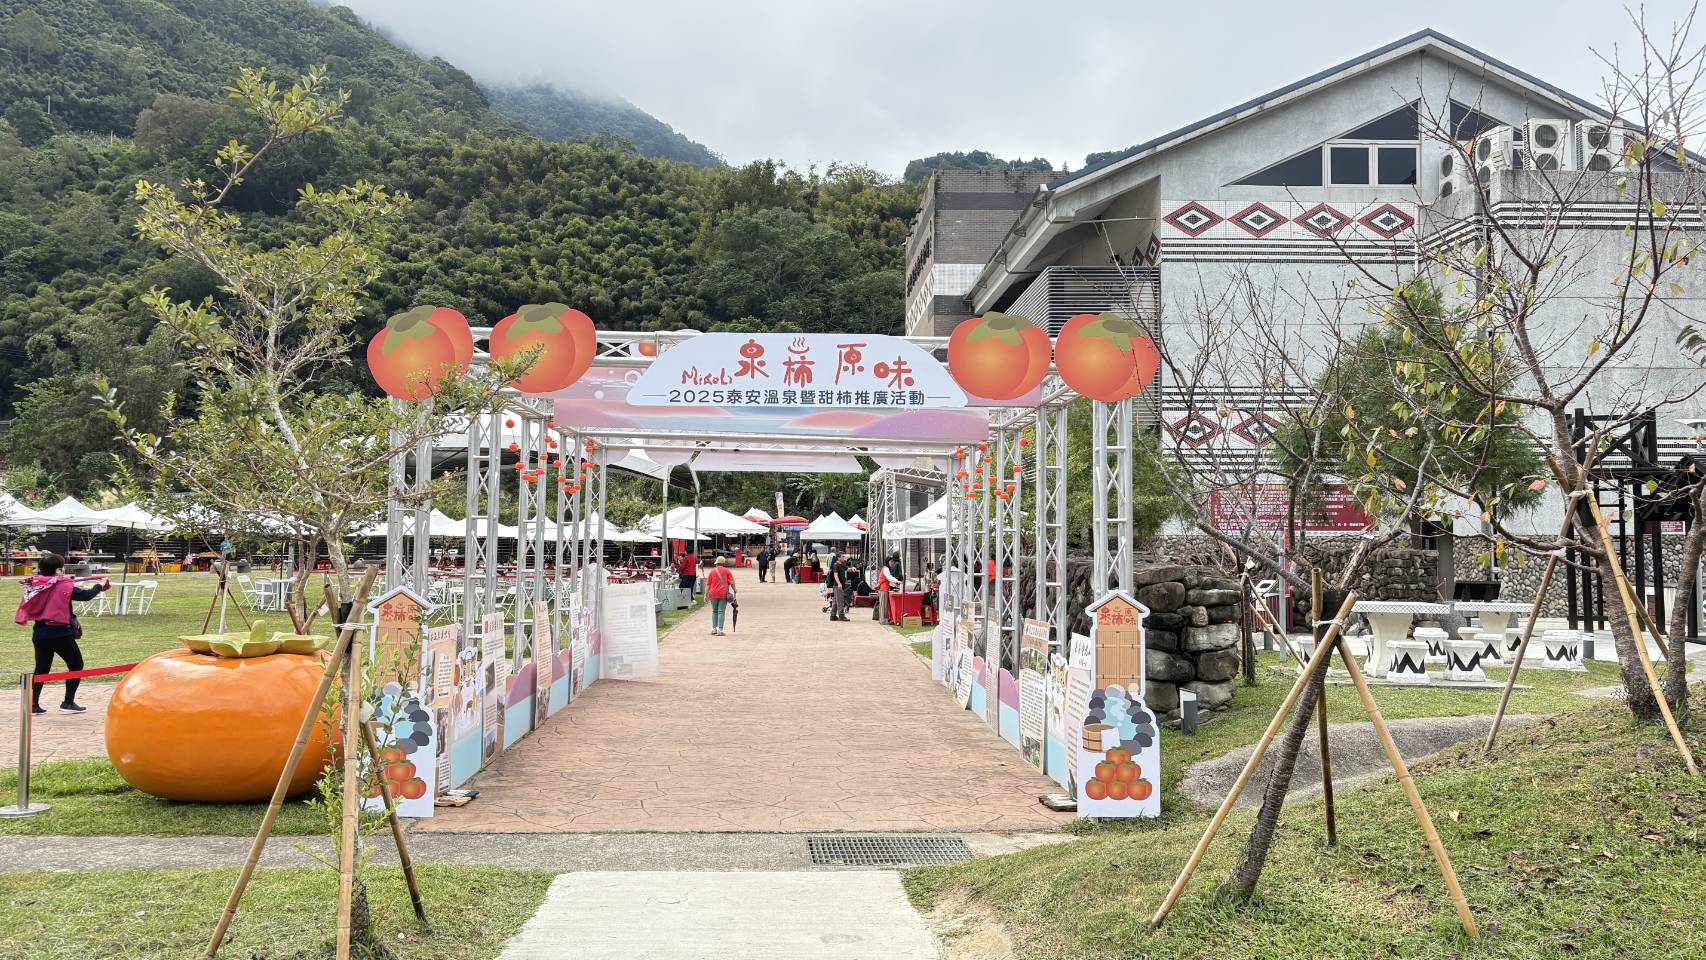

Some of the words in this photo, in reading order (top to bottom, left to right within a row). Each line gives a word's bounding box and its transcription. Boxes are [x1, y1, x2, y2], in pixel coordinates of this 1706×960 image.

[734, 338, 915, 390] 泉柿原味
[669, 389, 925, 405] 2025泰安溫泉暨甜柿推廣活動
